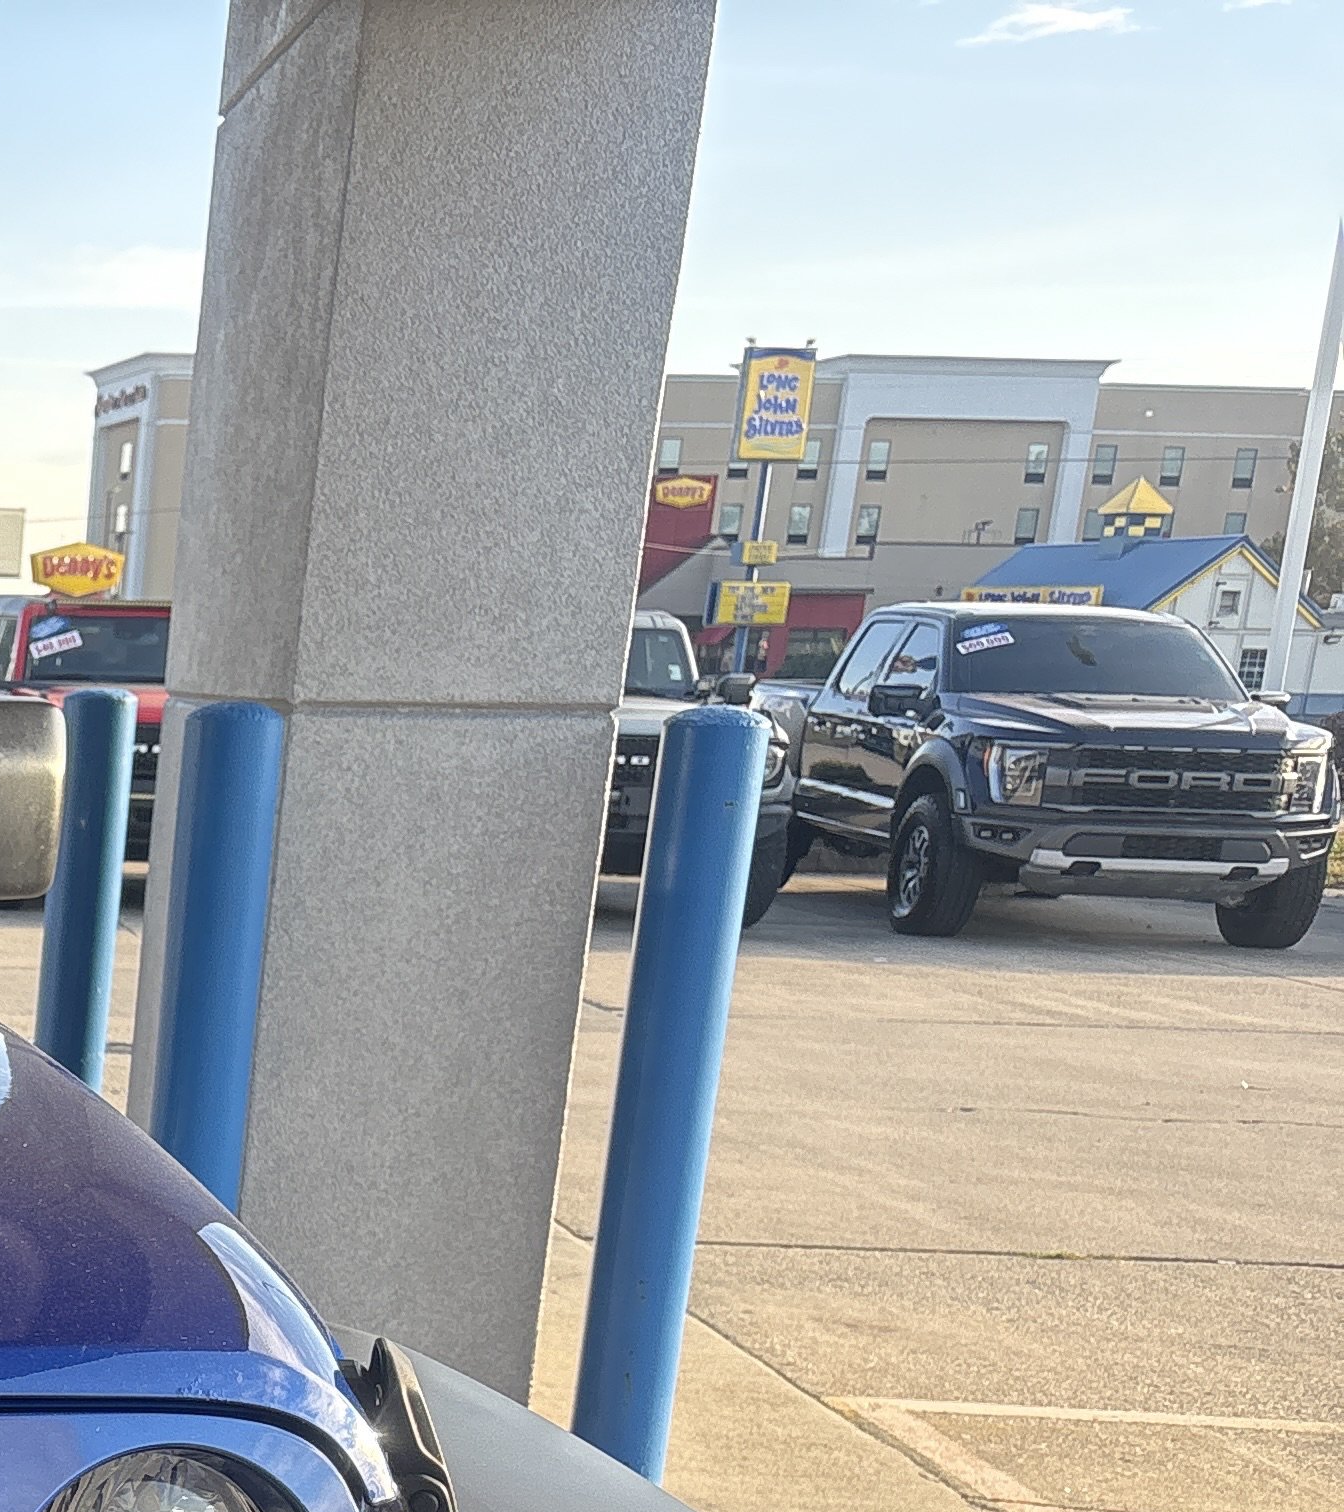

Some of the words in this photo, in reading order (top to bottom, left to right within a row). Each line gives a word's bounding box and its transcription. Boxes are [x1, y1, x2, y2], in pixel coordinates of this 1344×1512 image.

[758, 371, 801, 392] LONG
[42, 552, 118, 581] Denny's
[1073, 767, 1282, 793] FORD
